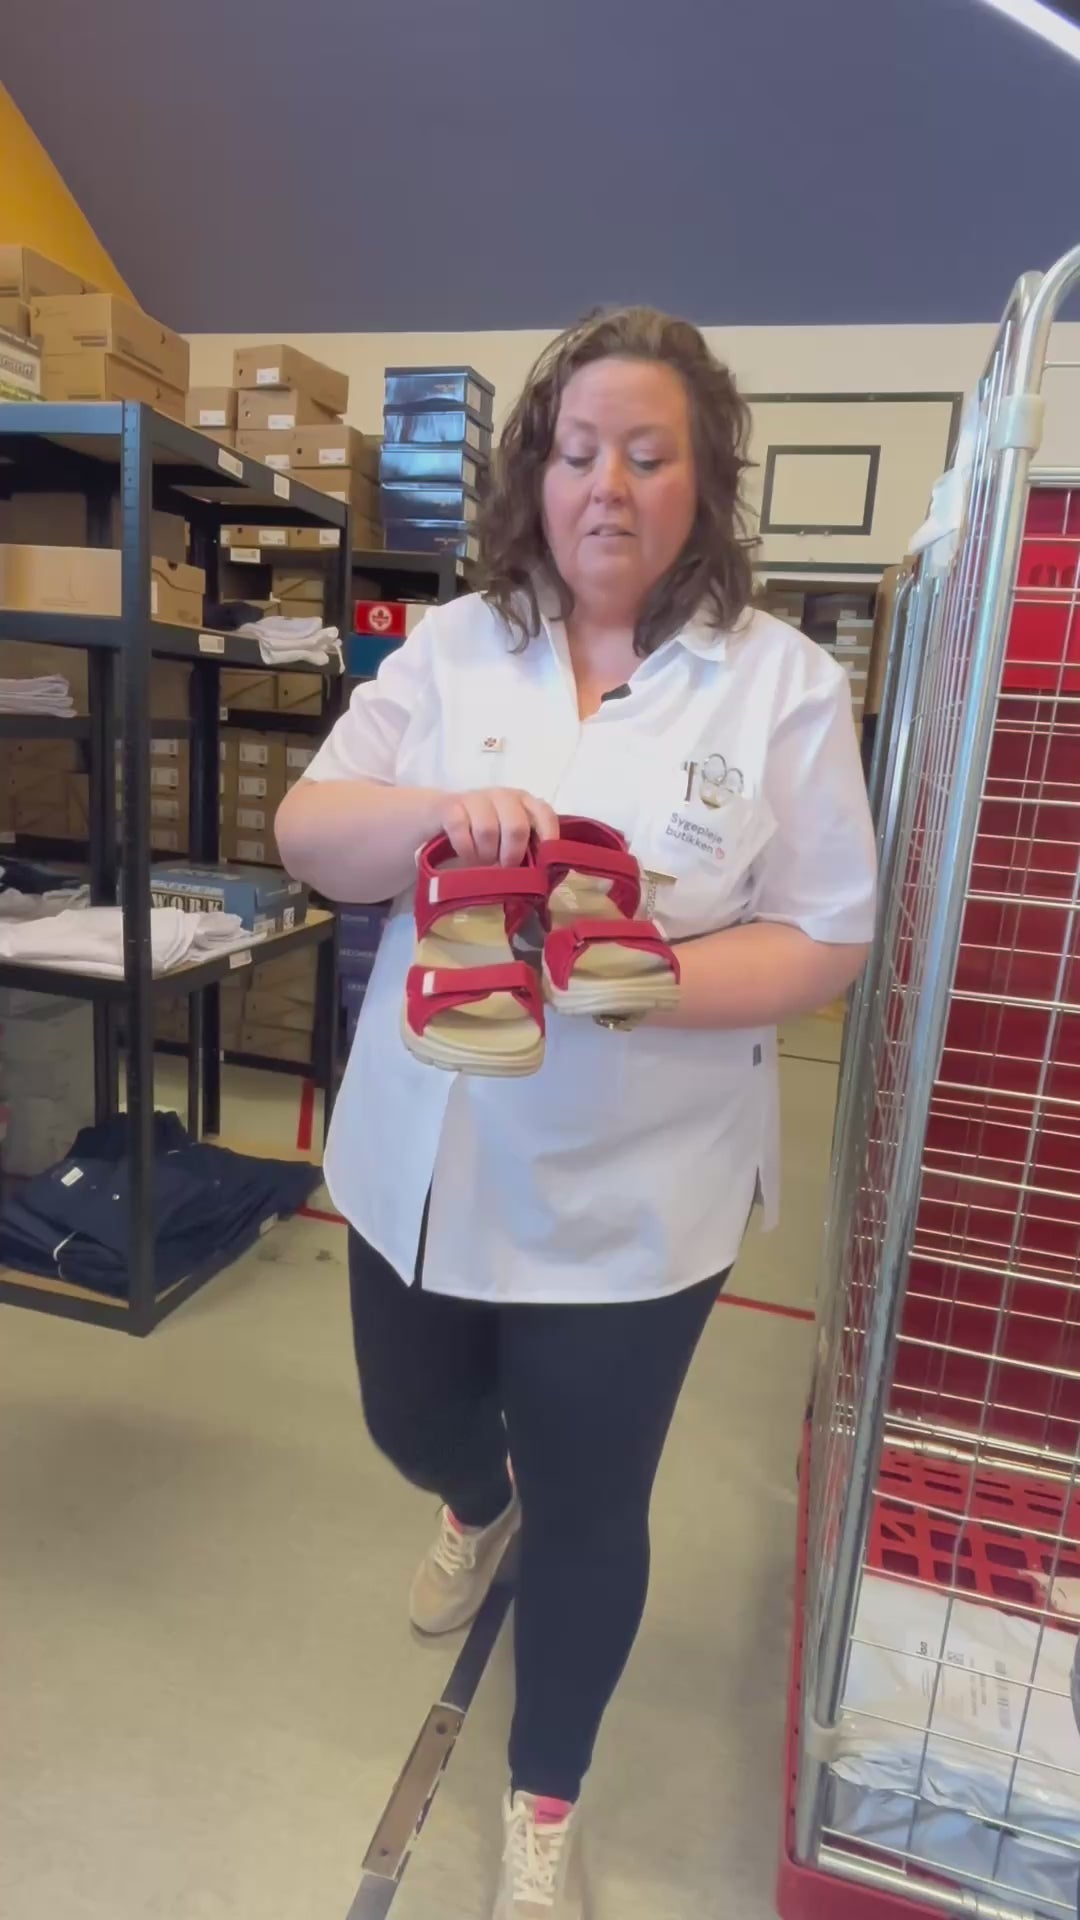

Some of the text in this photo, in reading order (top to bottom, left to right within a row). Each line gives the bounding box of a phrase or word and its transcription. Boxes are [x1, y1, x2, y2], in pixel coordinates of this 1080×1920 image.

[666, 826, 713, 853] butikken
[671, 813, 723, 844] Sygepleje
[152, 894, 221, 912] WORK
